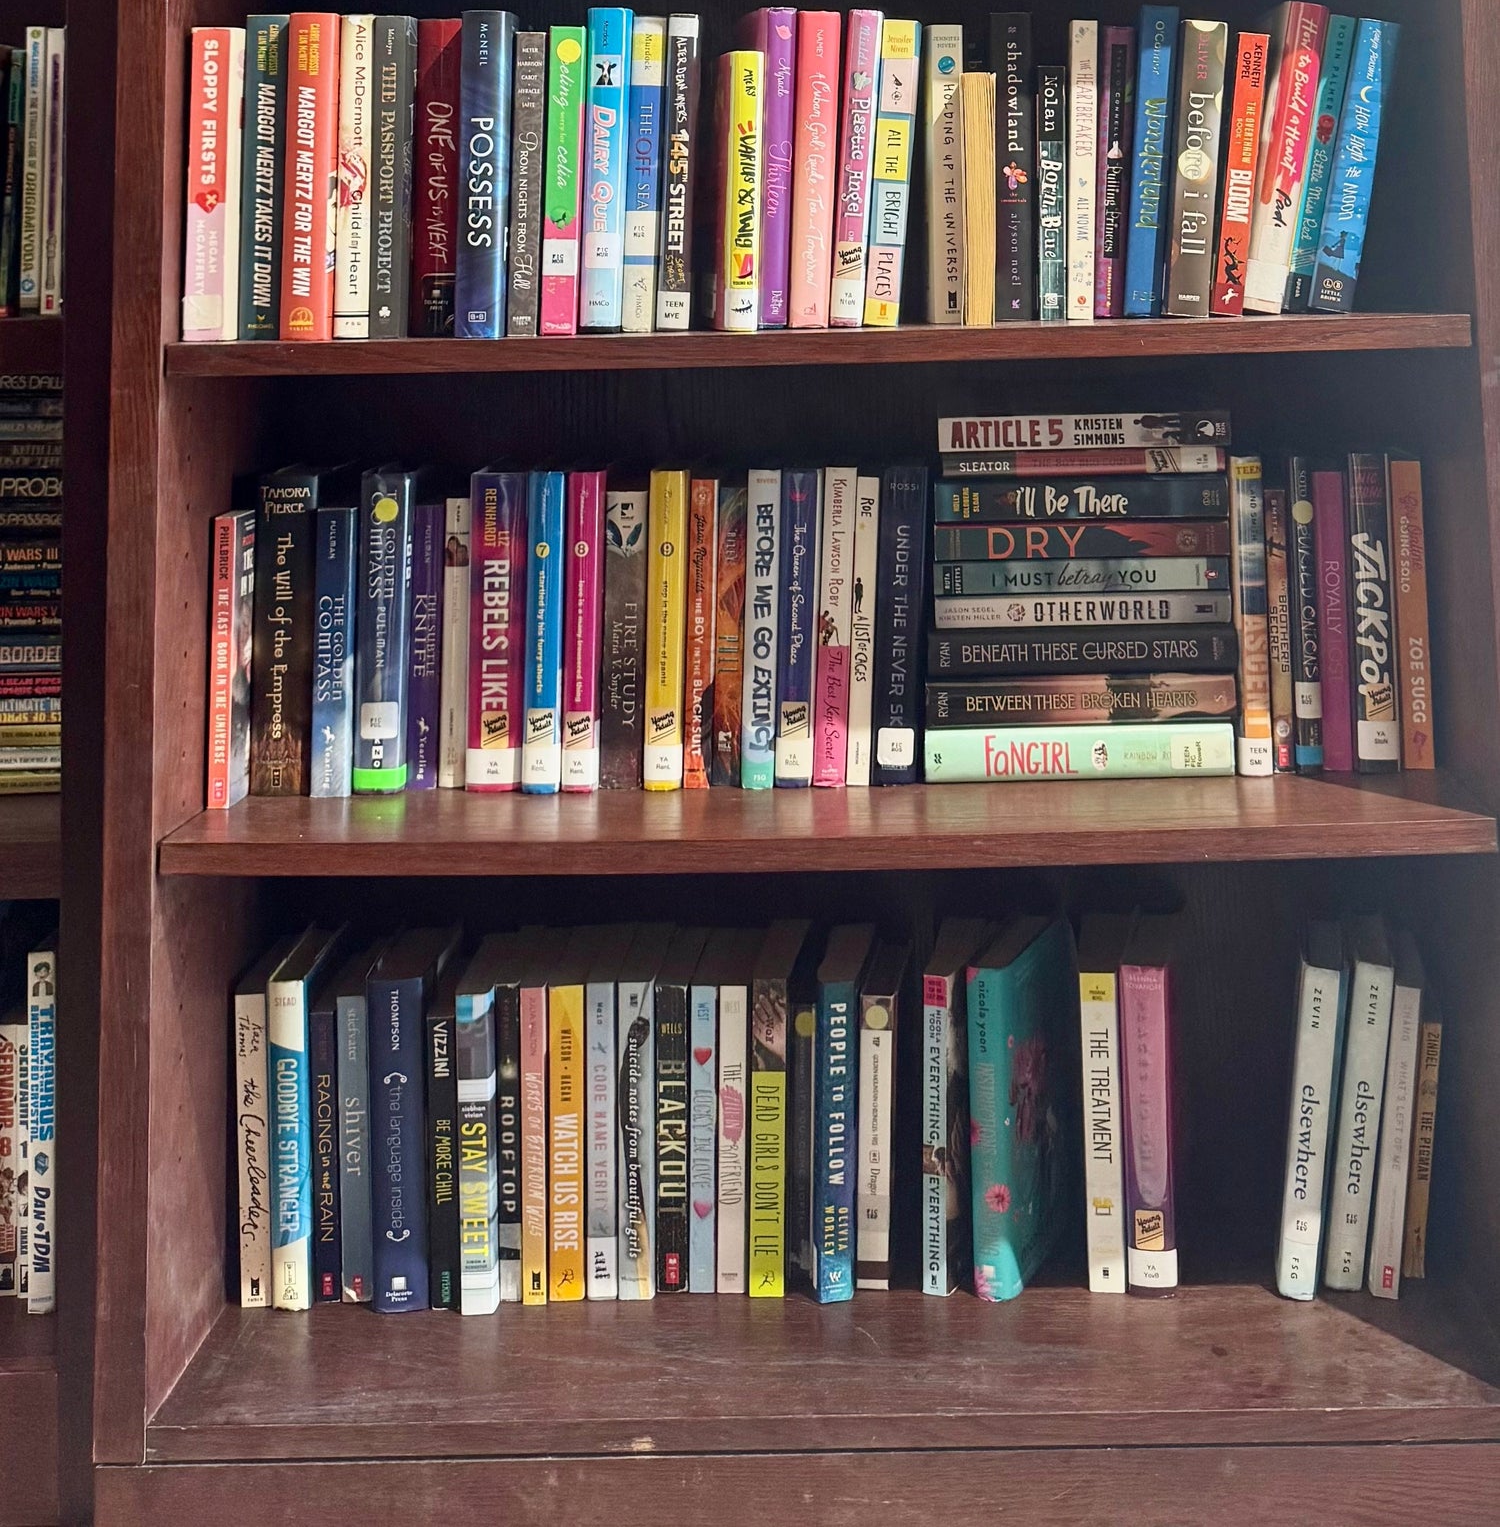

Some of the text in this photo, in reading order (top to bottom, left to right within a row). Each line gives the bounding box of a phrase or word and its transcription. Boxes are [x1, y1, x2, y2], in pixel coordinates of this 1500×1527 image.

[201, 39, 219, 185] SLOPPY FIRSTS
[1007, 42, 1024, 153] shadowland
[1044, 75, 1058, 132] Nolan
[1075, 59, 1094, 158] THE HEARTBREAKERS
[292, 86, 316, 297] MARGOT MERTZ FOR THE WIN
[376, 62, 397, 294] THE PASSPORT PROJECT
[467, 117, 494, 249] POSSESS
[885, 129, 902, 174] ALL THE
[1180, 92, 1215, 256] before i fall
[1226, 168, 1253, 224] BLOOM
[882, 191, 902, 237] BRIGHT
[874, 252, 894, 297] PLACES
[951, 419, 1064, 449] ARTICLE 5
[959, 461, 1011, 472] SLEATOR
[1073, 433, 1126, 446] SIMMONS
[1074, 419, 1124, 431] KRISTEN
[484, 488, 497, 548] REINHARDT
[987, 526, 1087, 559] DRY
[265, 532, 295, 740] The Will of the Empress
[482, 558, 511, 651] REBELS
[749, 504, 774, 753] BEFORE WE GO EXTINCT
[1033, 600, 1170, 622] OTHERWORLD
[622, 601, 637, 730] FIRE STUDY
[961, 640, 1200, 664] BENEATH THESE CURSED STARS
[1409, 637, 1427, 724] ZOE SUGG
[390, 989, 400, 1051] THOMPSON
[432, 1021, 451, 1078] VIZZINI
[1310, 988, 1322, 1030] ZEVIN
[1367, 985, 1379, 1027] ZEVIN
[345, 1097, 367, 1177] shiver
[828, 1002, 847, 1186] PEOPLE TO FOLLOW
[1090, 1028, 1112, 1164] THE TREATMENT
[1347, 1080, 1376, 1195] elsewhere
[278, 1058, 300, 1233] GOODBYE STRANGER
[552, 1113, 578, 1252] WATCH US RISE
[753, 1085, 781, 1258] DEAD GIRLS DON'T LIE
[925, 1045, 943, 1272] EVERYTHING, EVERYTHING
[1293, 1084, 1320, 1201] elsewhere
[461, 1123, 488, 1258] STAY SWEET
